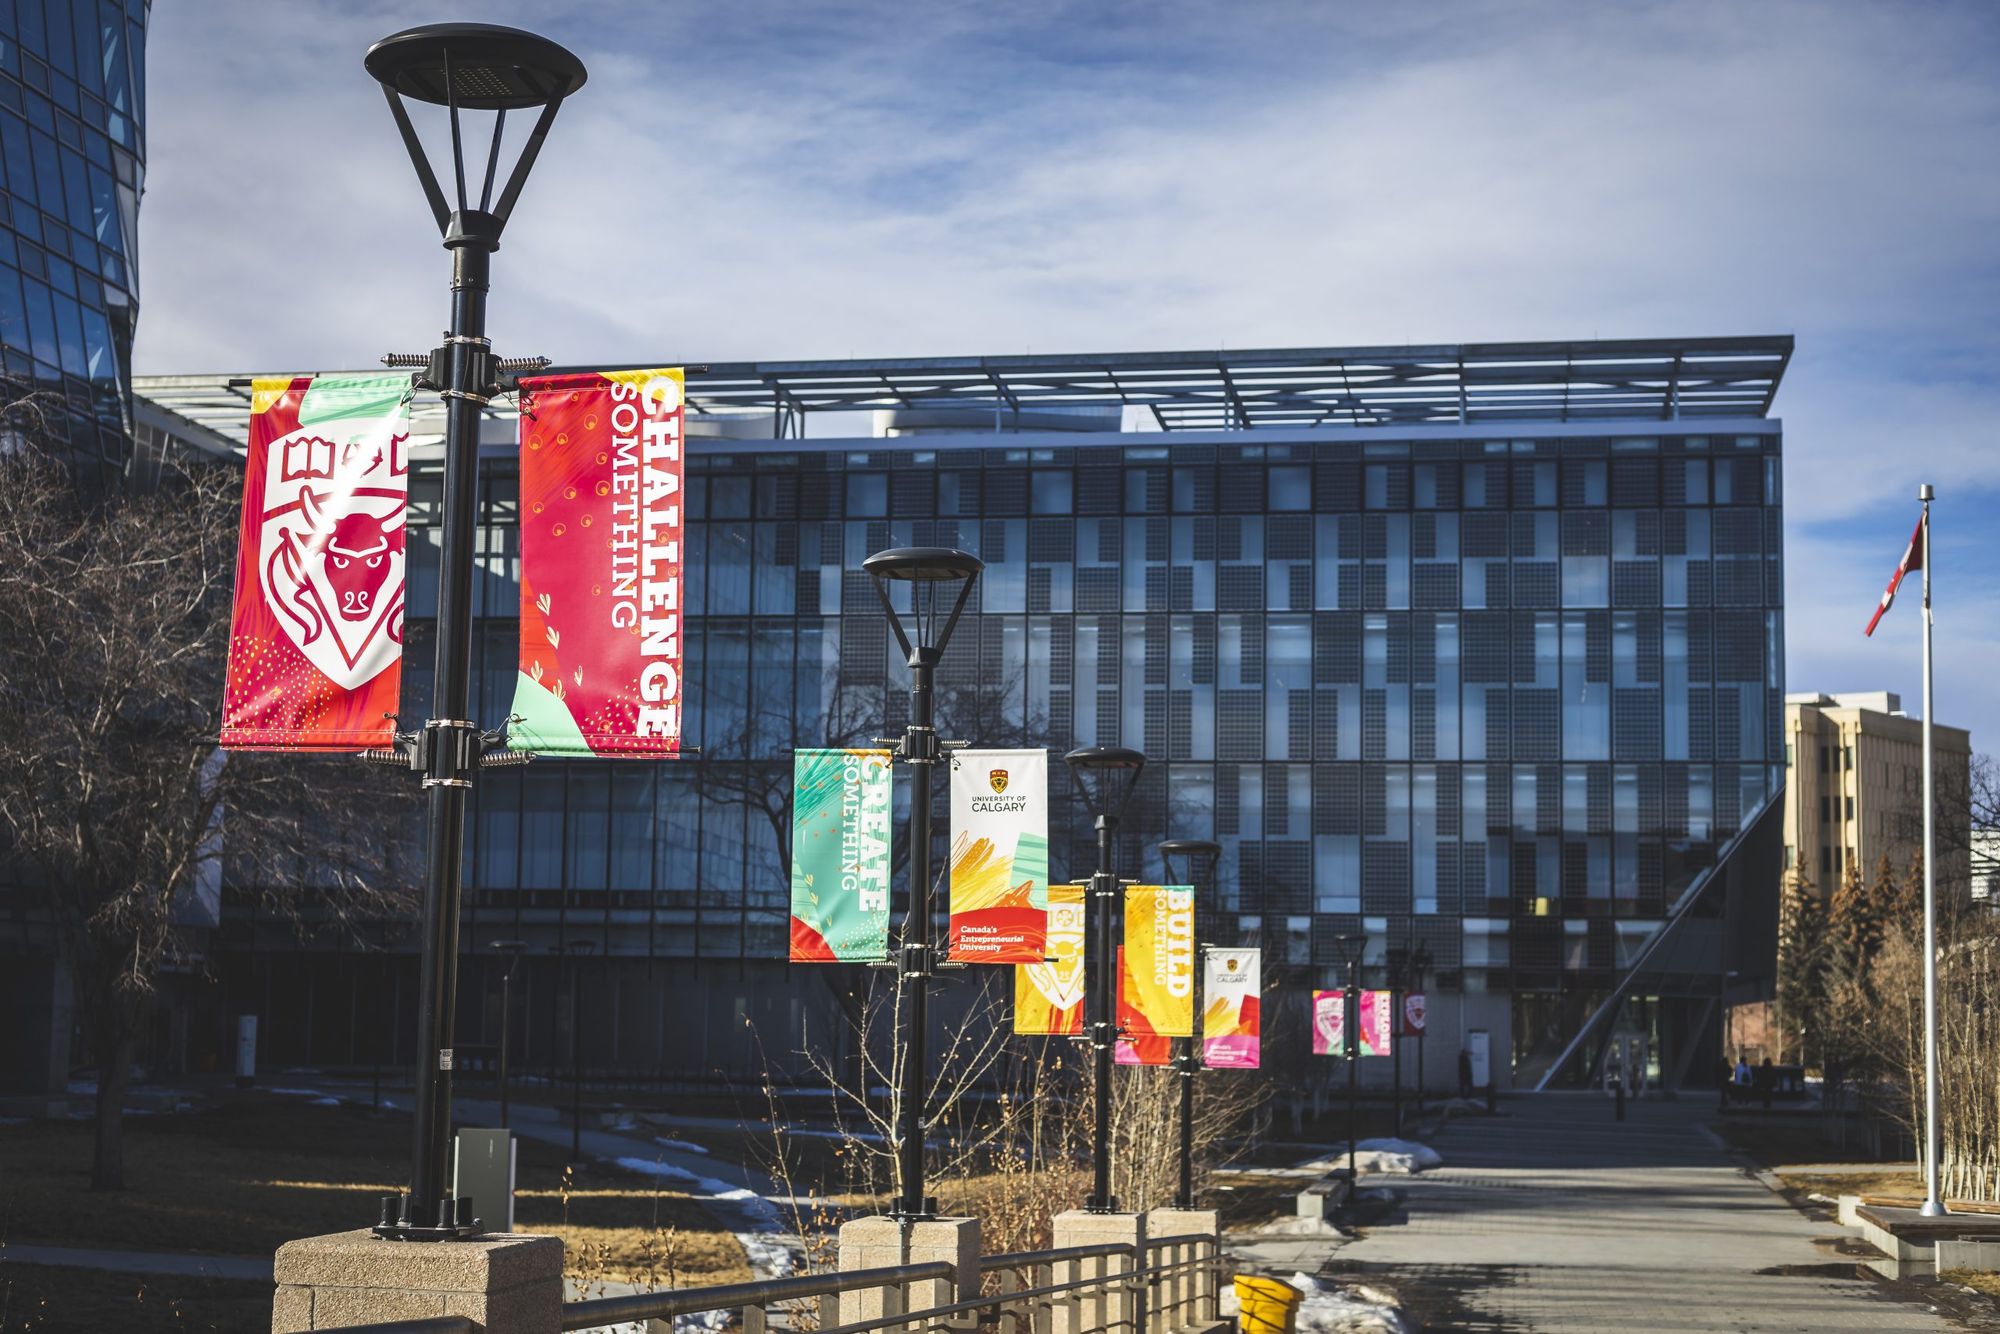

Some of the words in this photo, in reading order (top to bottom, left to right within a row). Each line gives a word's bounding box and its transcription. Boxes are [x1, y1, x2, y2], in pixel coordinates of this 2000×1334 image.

[610, 381, 639, 629] SOMETHING
[636, 375, 679, 738] CHALLENGE
[841, 755, 859, 891] SOMETHING
[859, 754, 889, 912] CREATE
[971, 802, 1027, 812] CALGARY
[959, 944, 1002, 952] University
[960, 925, 998, 934] Canada's
[960, 935, 1024, 945] Entrepreneurial
[1154, 889, 1167, 986] SOMETHING
[1167, 889, 1192, 998] BUILD
